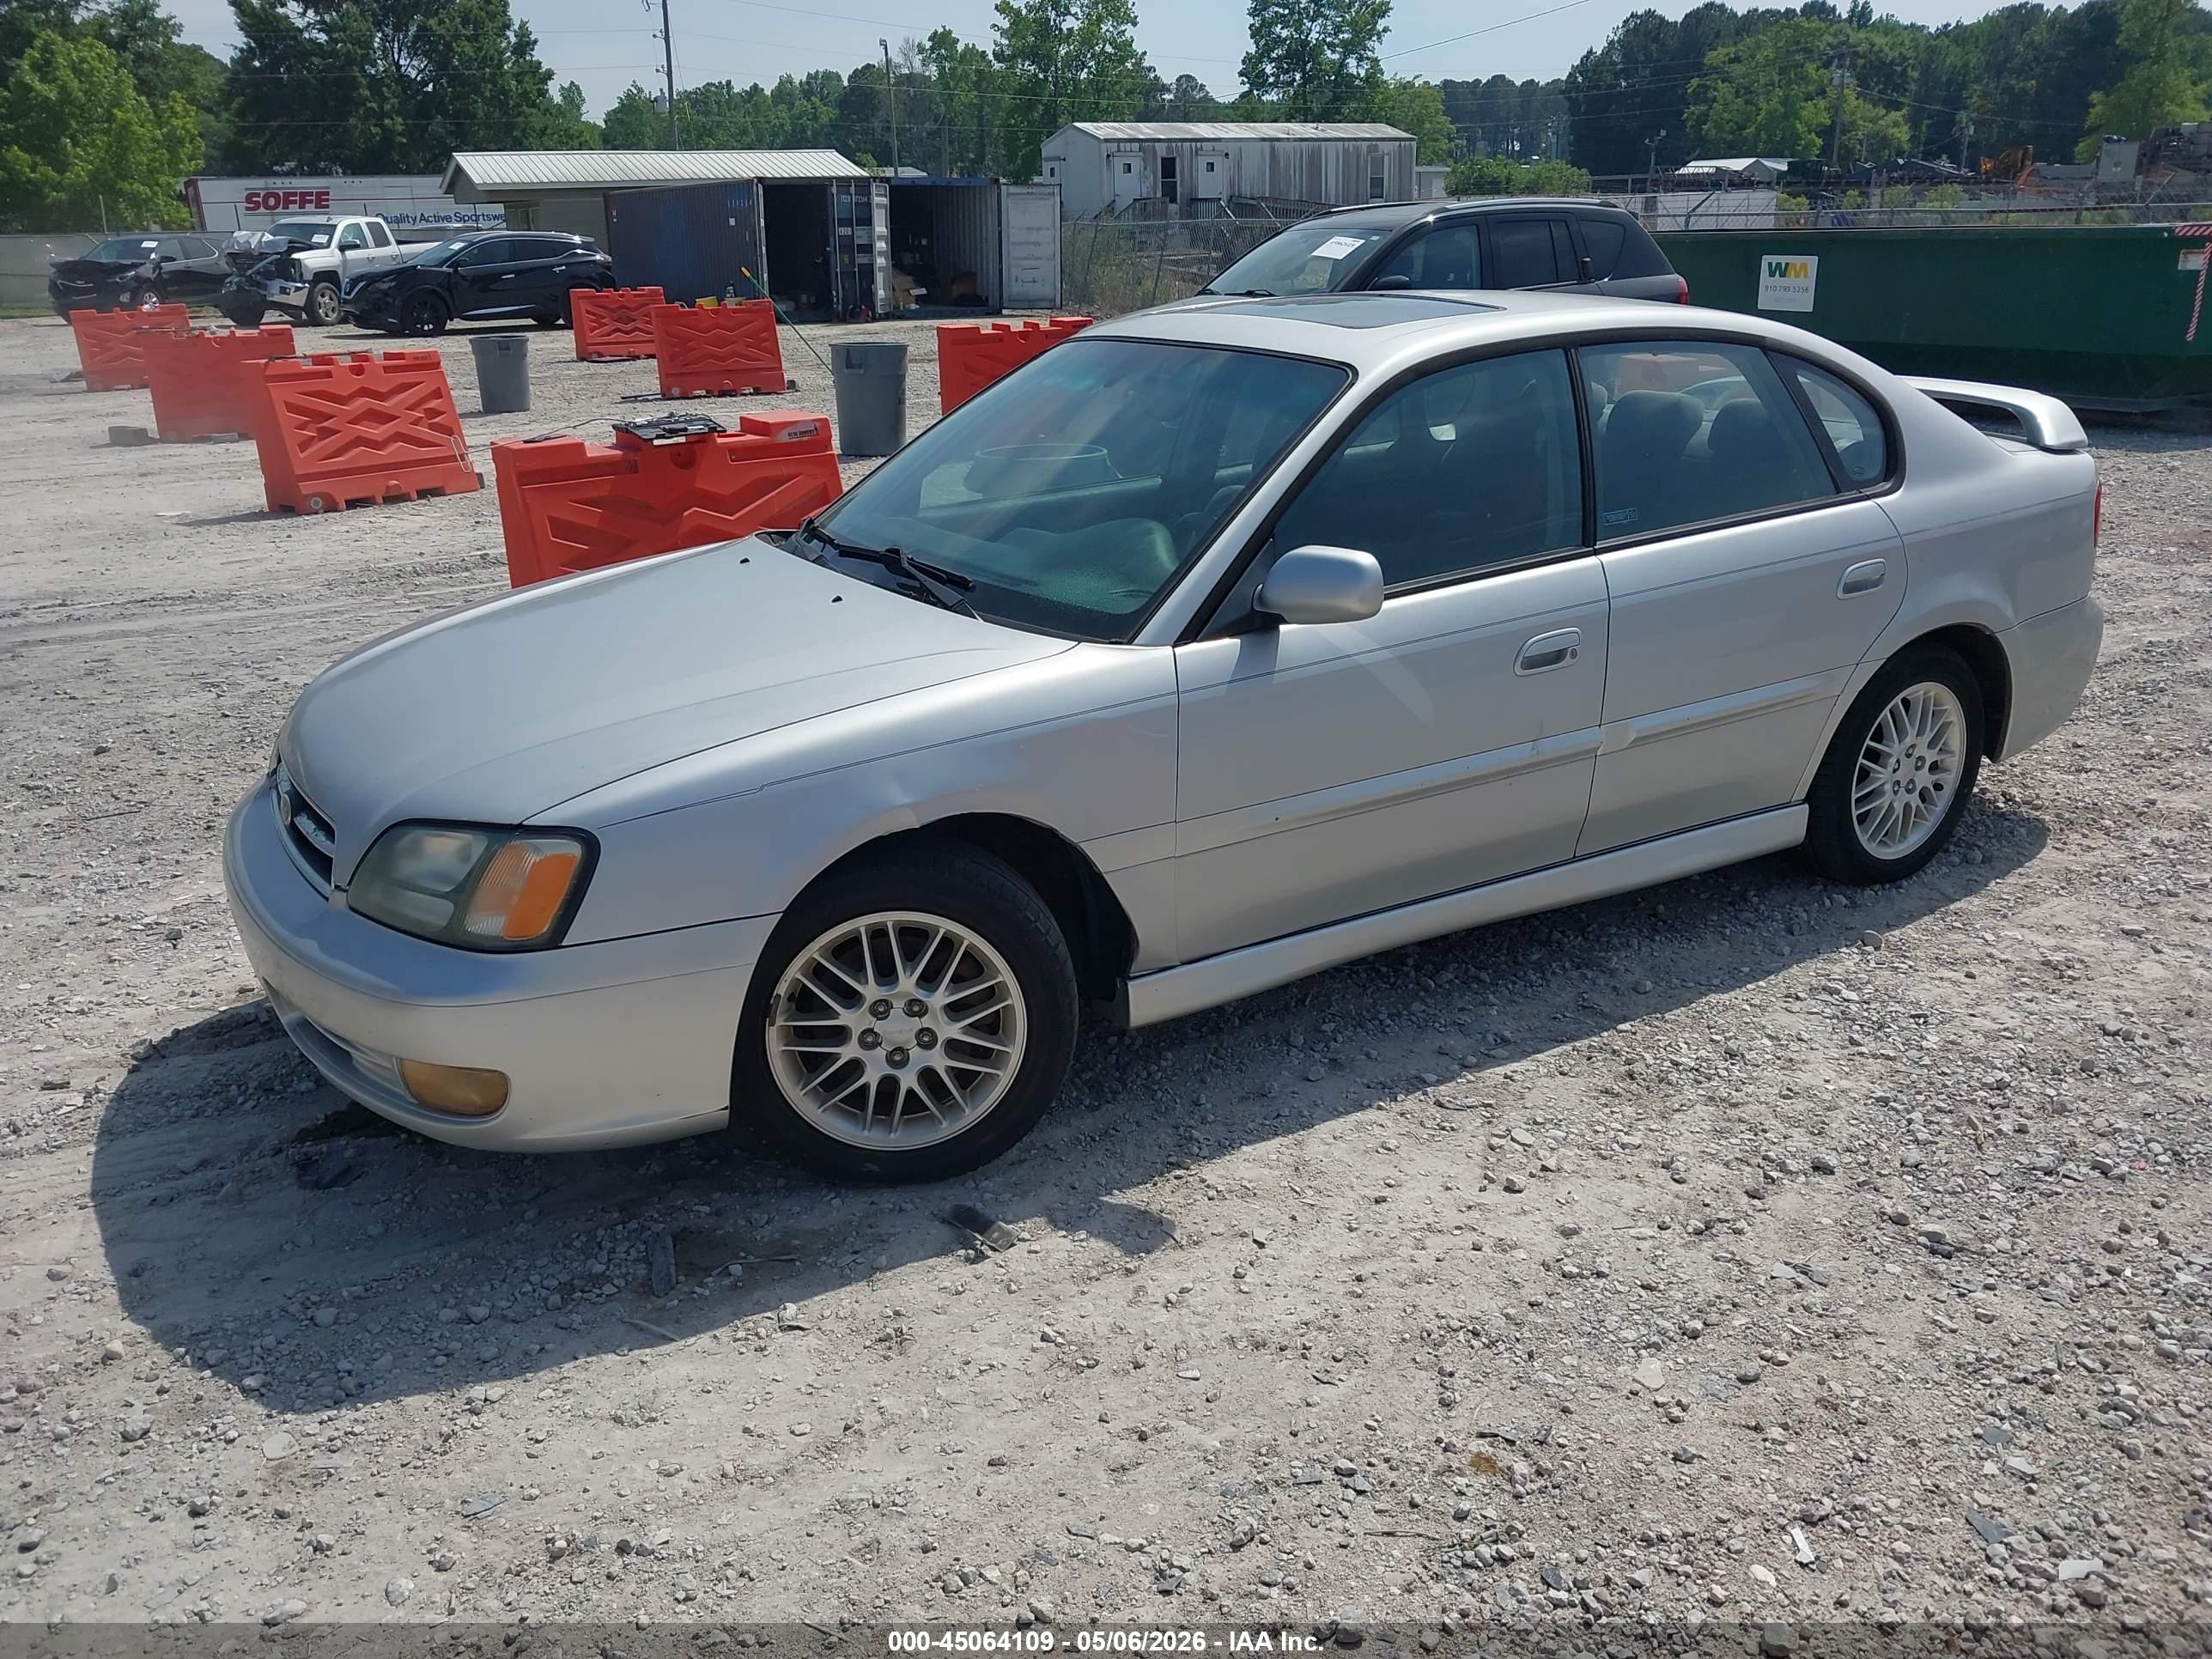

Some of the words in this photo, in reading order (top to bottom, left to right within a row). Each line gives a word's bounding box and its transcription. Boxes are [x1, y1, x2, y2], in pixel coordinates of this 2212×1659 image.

[245, 191, 330, 211] SOFFE
[419, 212, 452, 224] Active
[1767, 261, 1808, 278] WM
